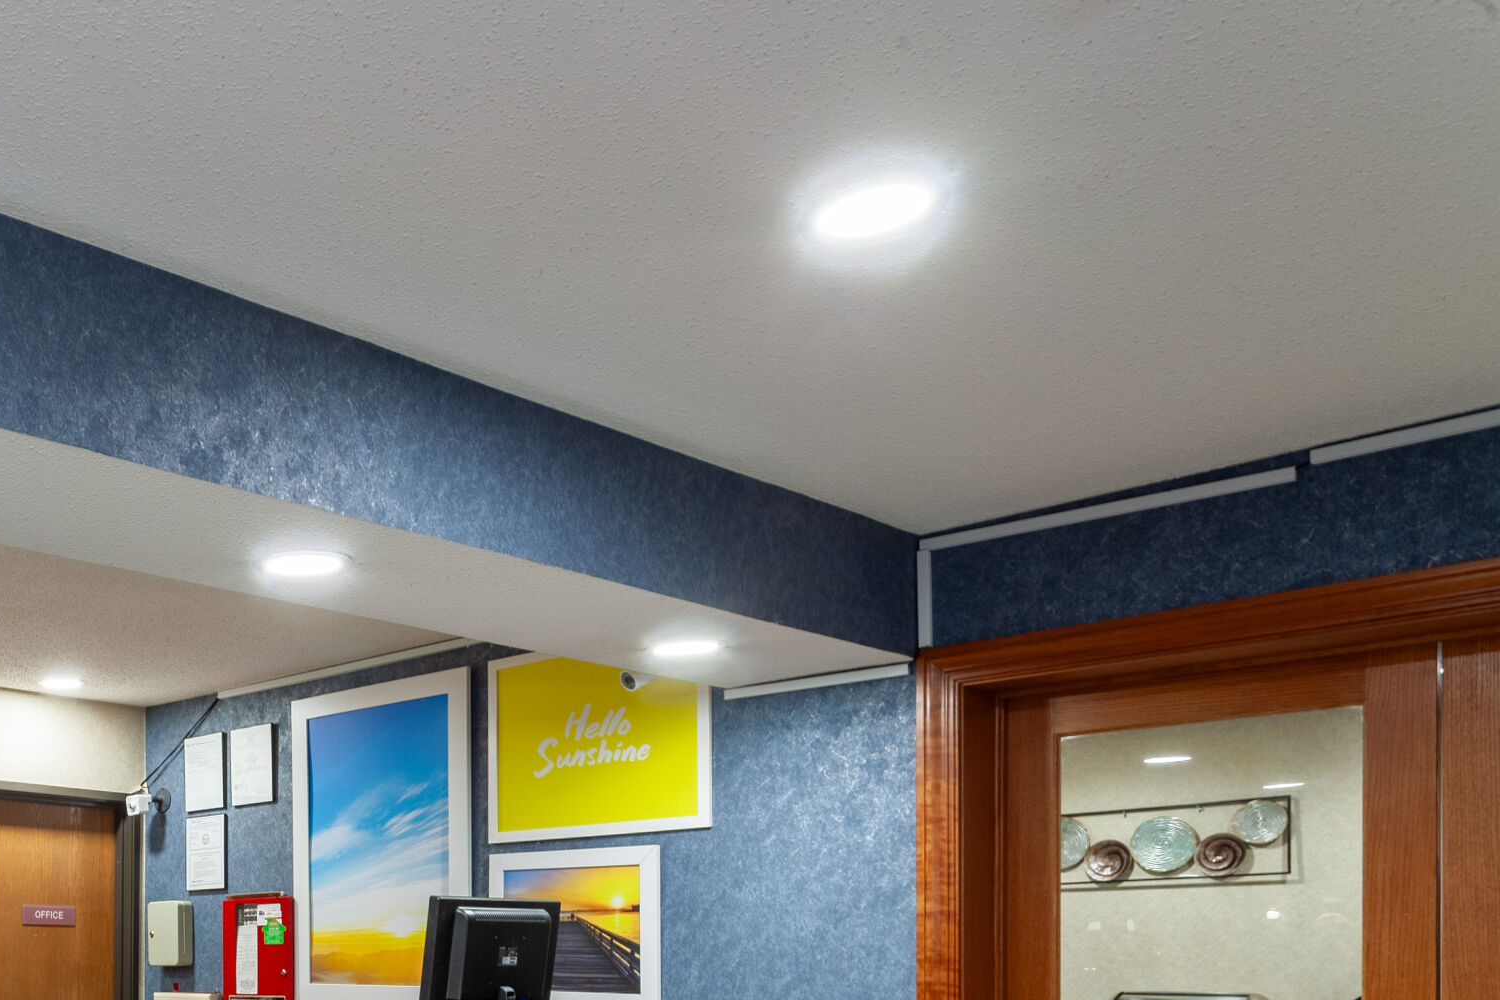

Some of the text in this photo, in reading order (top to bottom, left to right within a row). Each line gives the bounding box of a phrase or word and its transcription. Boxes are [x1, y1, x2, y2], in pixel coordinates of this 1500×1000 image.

[564, 702, 631, 741] Hello
[533, 737, 651, 778] Sunshine
[34, 910, 64, 920] OFFICE
